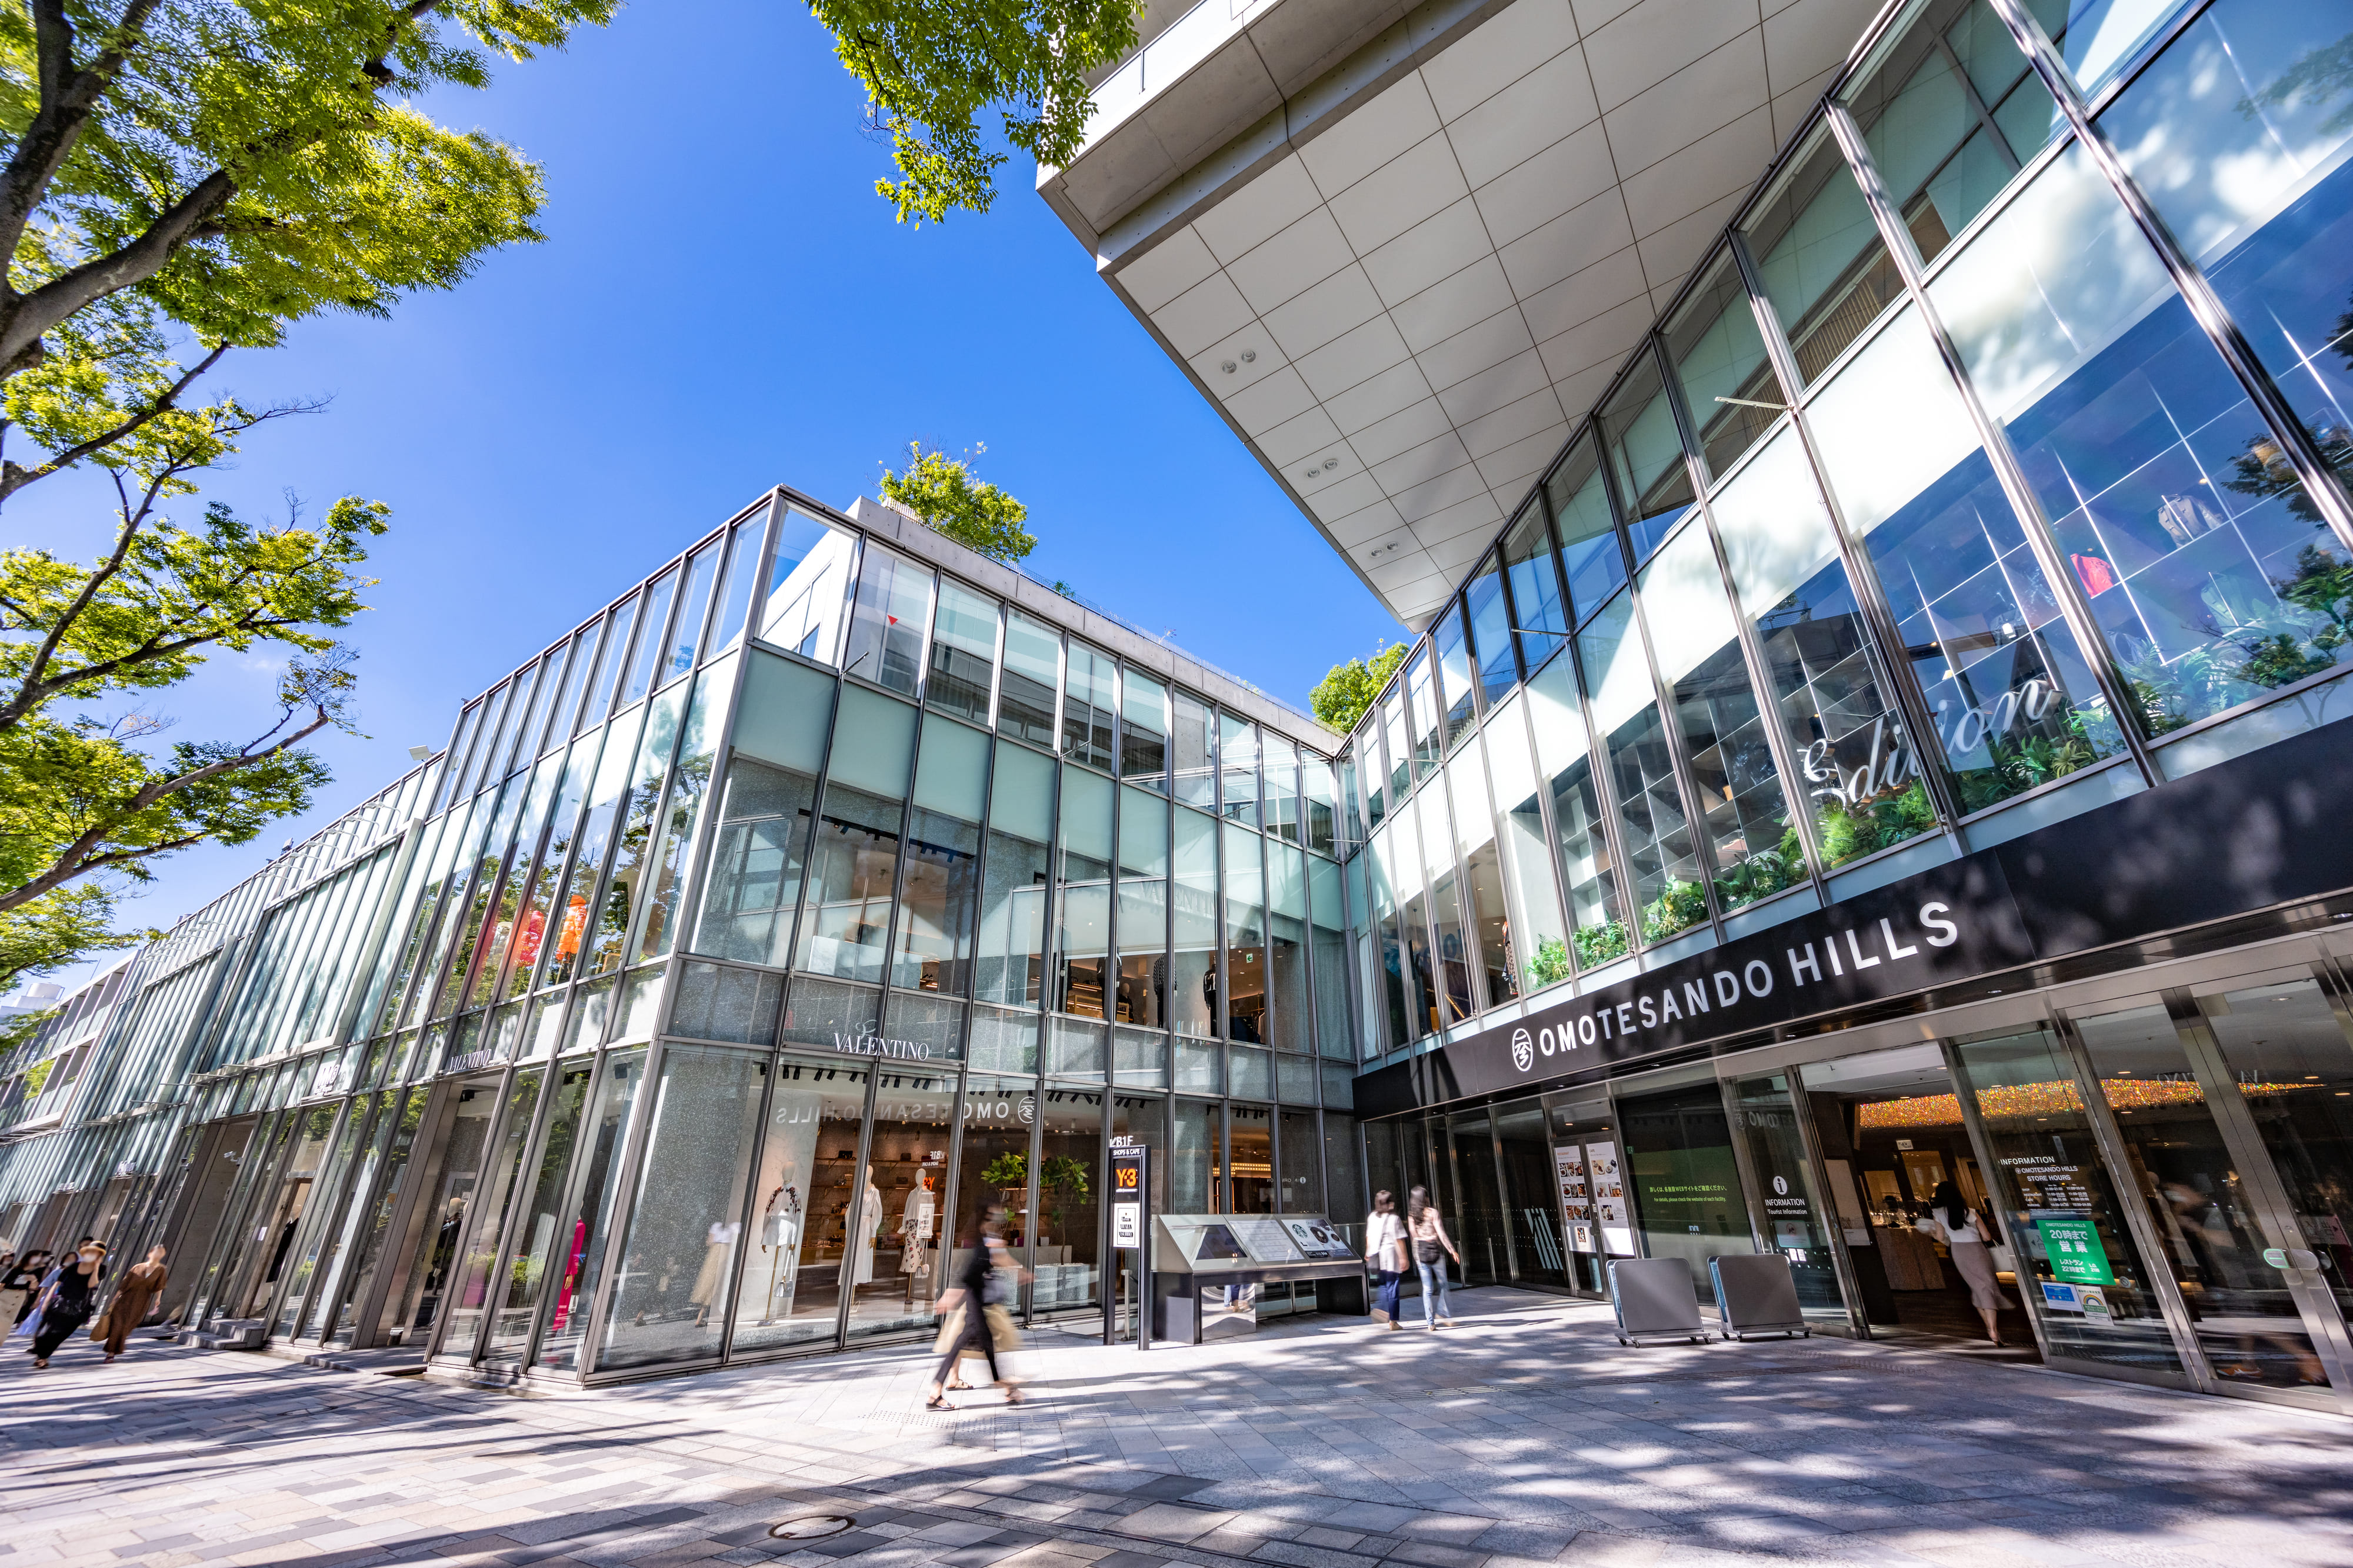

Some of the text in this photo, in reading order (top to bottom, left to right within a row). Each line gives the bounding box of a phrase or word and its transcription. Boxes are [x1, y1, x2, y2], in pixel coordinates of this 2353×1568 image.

[1785, 678, 2062, 826] Ediion
[1539, 902, 1958, 1057] OMOTESANDO HILLS
[834, 1032, 929, 1061] VALENTINO
[449, 1048, 492, 1072] VALENTINO
[1116, 1135, 1134, 1147] B1F
[2001, 1156, 2055, 1166] INFORMATION
[1765, 1198, 1805, 1206] INFORMATION
[2049, 1229, 2088, 1240] 20時まで
